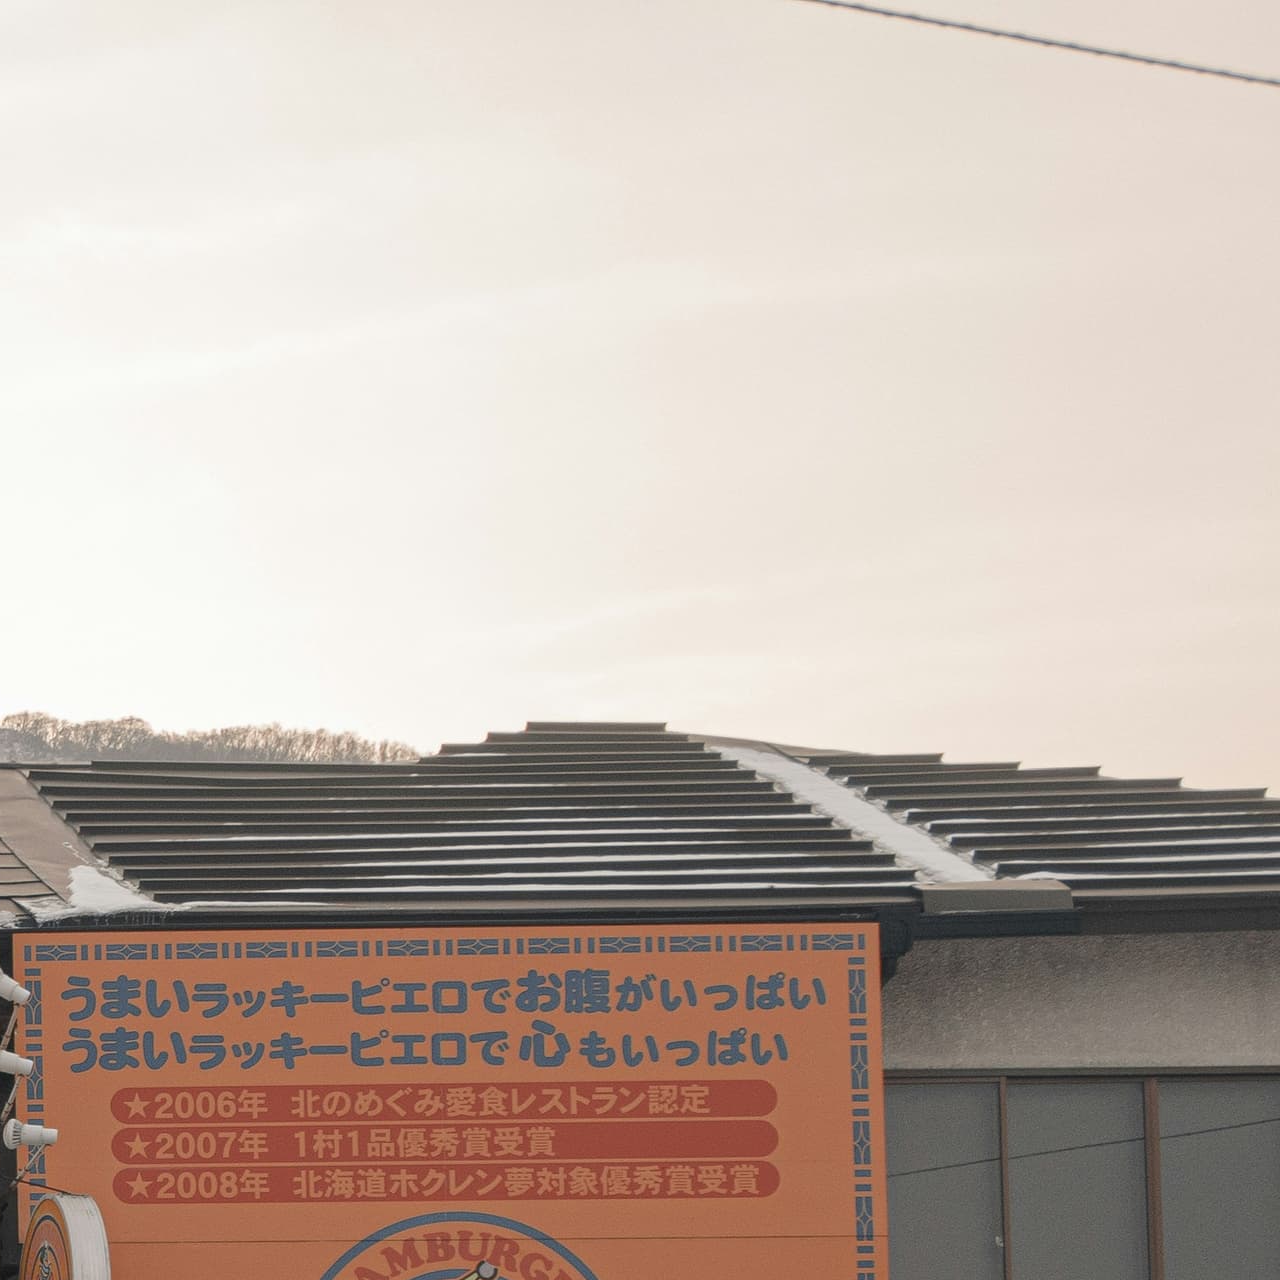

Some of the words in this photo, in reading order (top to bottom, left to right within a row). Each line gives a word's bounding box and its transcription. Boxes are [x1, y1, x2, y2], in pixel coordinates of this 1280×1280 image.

[60, 967, 828, 1022] うまいラッキーピエロでお腹がいっぱい
[60, 1021, 789, 1073] うまいラッキーピエロで心もいっぱい
[291, 1084, 710, 1119] 北のめぐみ愛食レストラン認定
[294, 1128, 556, 1160] 1村1品優秀賞受賞
[293, 1166, 760, 1199] 北海道ホクレン夢対象優秀賞受賞
